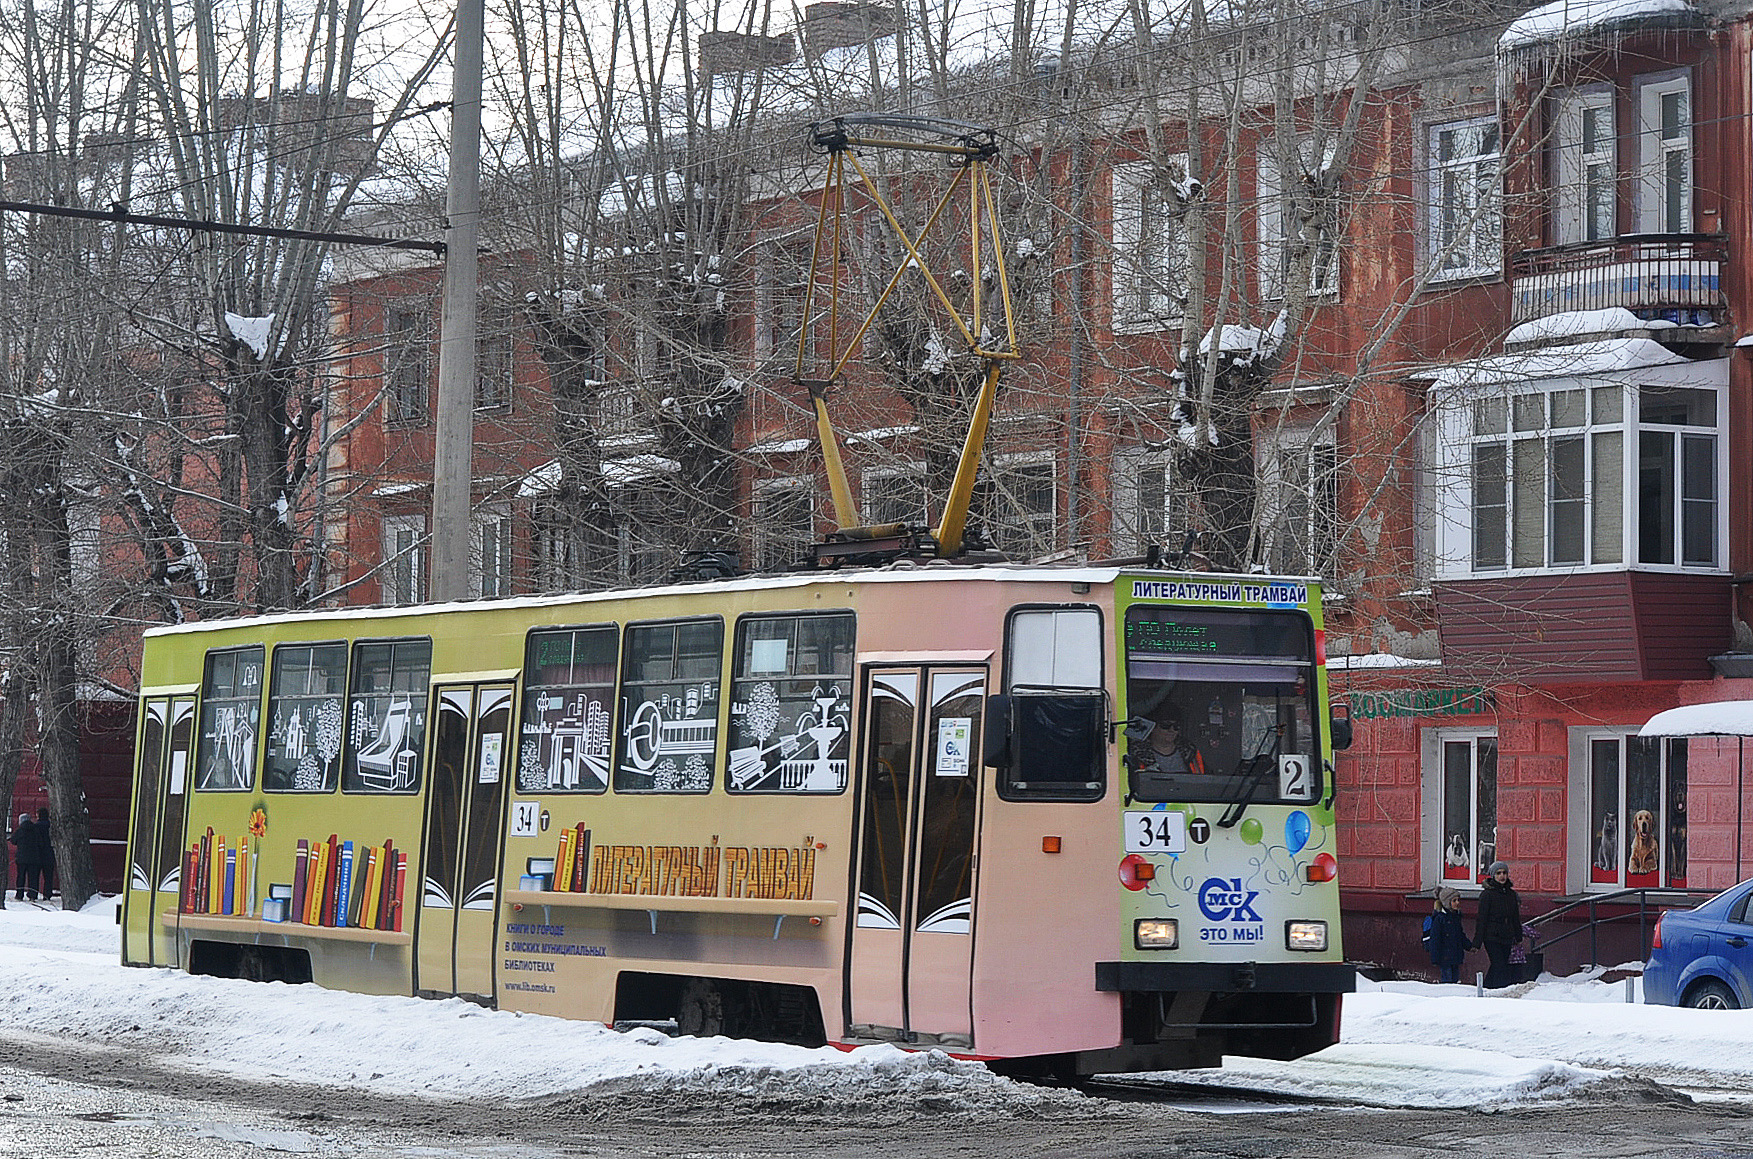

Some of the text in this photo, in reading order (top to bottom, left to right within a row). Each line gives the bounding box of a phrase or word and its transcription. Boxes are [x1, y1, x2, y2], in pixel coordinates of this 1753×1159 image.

[1133, 582, 1307, 603] ЛИТЕРАТУРНЫЙ ТРАМВАЙ
[1284, 760, 1305, 795] 2
[517, 806, 532, 831] 34
[1139, 817, 1171, 847] 34
[590, 835, 720, 897] ЛИТЕРАТУРНЫЙ
[725, 836, 816, 900] ТРАМВАЙ
[506, 923, 564, 936] КНИГИ О ГОРОДЕ
[505, 941, 607, 957] В ОМСКИХ МУНИЦИПАЛЬНЫХ
[505, 960, 555, 972] БИБЛИОТЕКАХ
[505, 982, 555, 993] www.lib.omsk.ru
